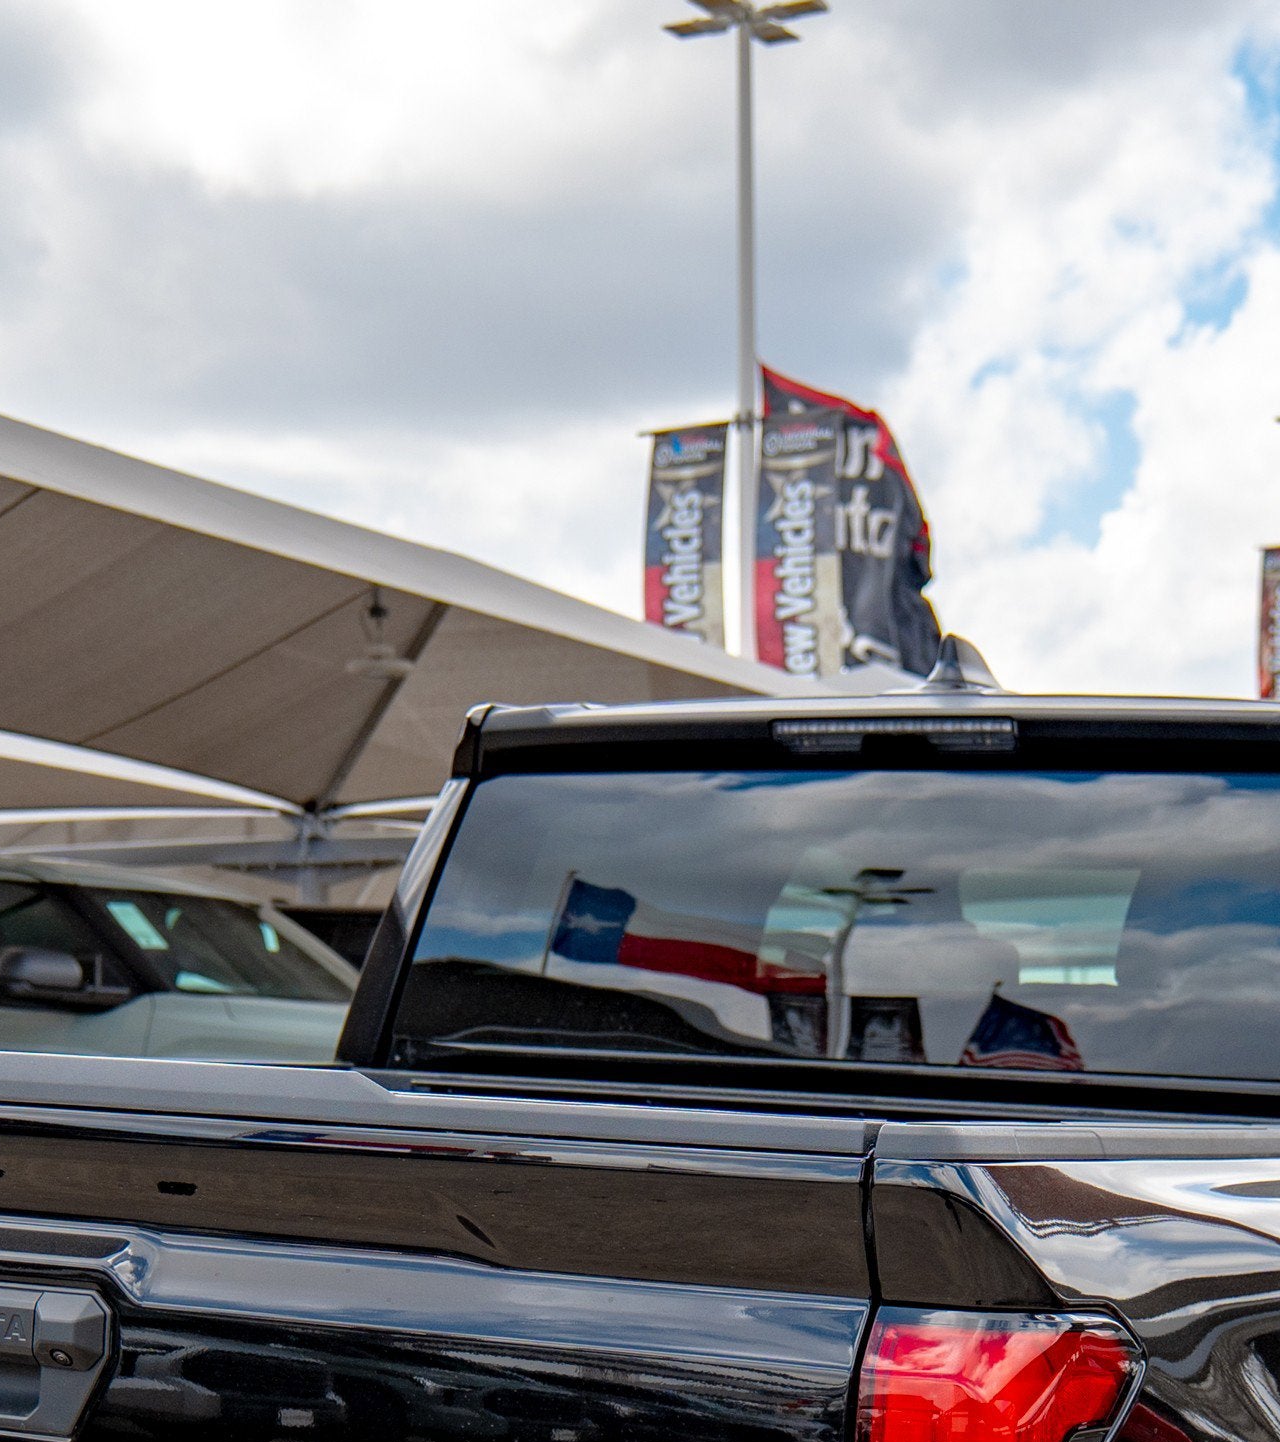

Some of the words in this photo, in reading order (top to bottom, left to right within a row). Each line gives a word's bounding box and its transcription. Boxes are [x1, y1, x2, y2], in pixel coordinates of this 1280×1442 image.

[661, 488, 703, 628] Vehicles
[774, 478, 816, 620] Vehicles
[783, 622, 818, 678] ew
